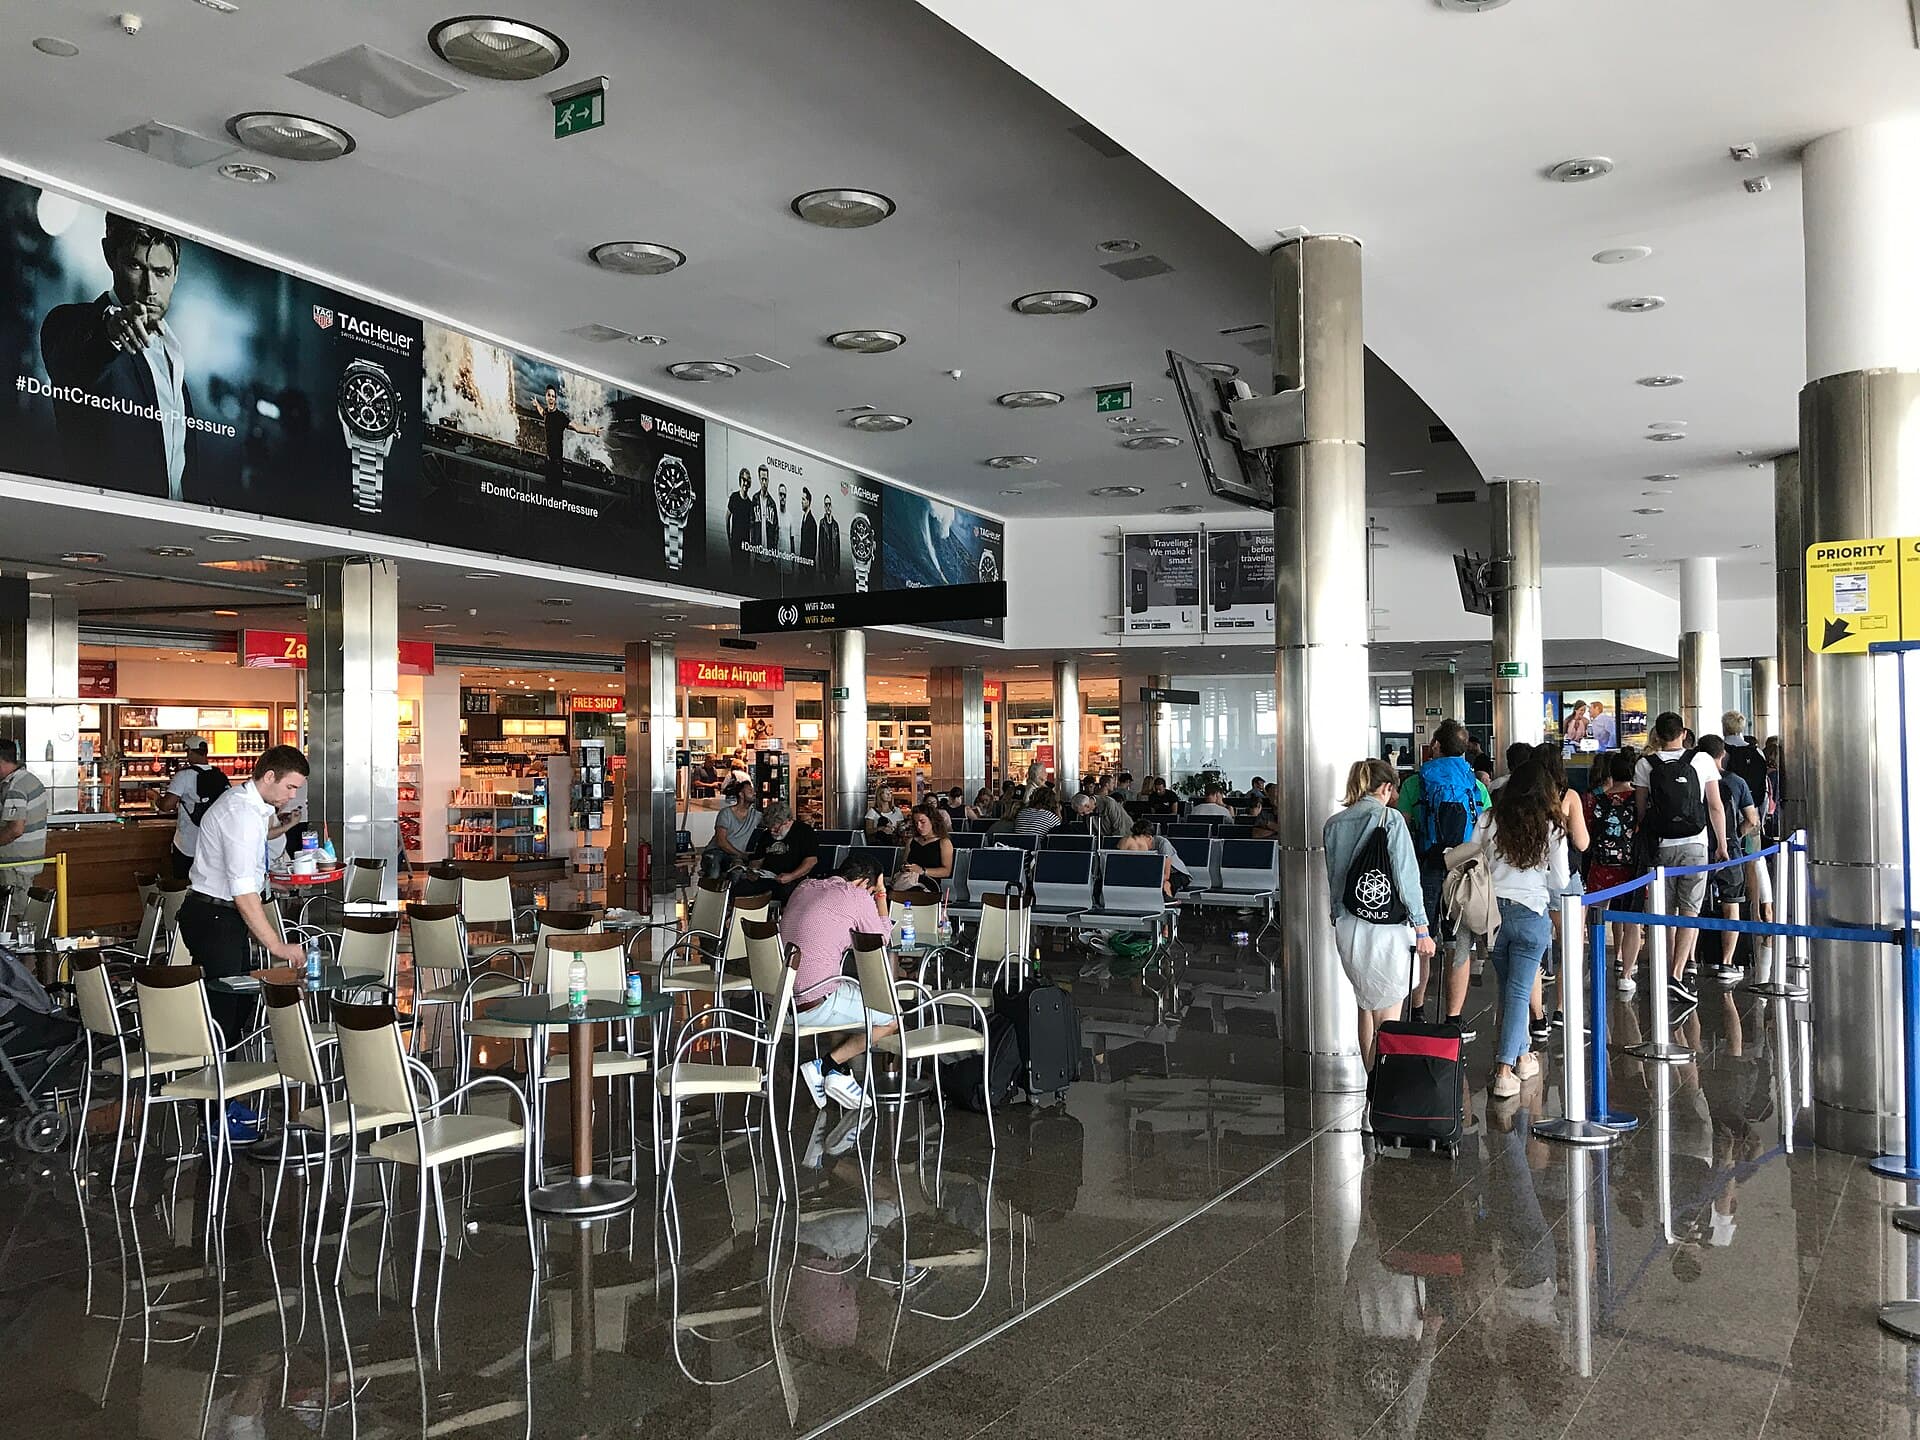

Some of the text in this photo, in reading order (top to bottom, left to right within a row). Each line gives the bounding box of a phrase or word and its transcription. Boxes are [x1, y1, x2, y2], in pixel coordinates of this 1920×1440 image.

[15, 375, 237, 438] #DontCrackUnderPressure
[766, 456, 803, 476] ONEREPUBLIC
[480, 481, 599, 518] #DontCrackUnderPressure
[1154, 538, 1193, 548] Traveling?
[1149, 547, 1193, 556] We make it
[1817, 545, 1885, 560] PRIORITY
[1168, 557, 1193, 565] smart.
[805, 602, 835, 611] WiFi Zona
[805, 615, 835, 624] WiFi Zone
[698, 663, 767, 686] Zadar Airport
[983, 684, 998, 697] adar
[573, 697, 618, 709] FREE SHOP
[1356, 907, 1389, 919] SONUS
